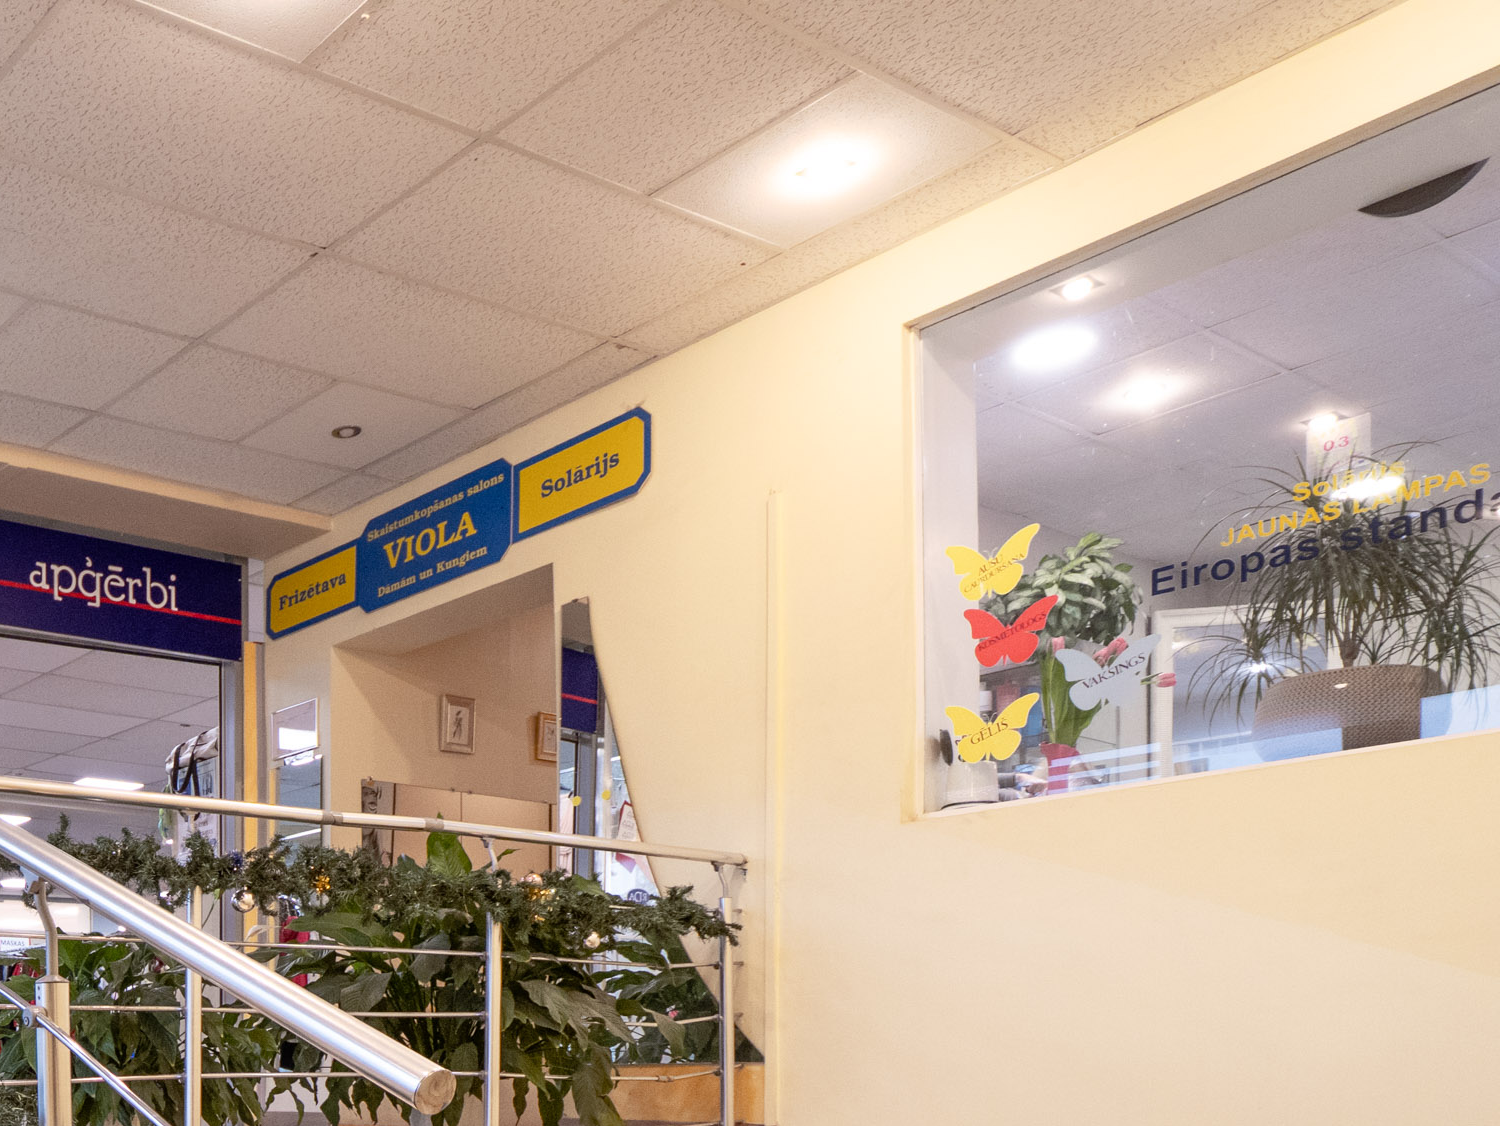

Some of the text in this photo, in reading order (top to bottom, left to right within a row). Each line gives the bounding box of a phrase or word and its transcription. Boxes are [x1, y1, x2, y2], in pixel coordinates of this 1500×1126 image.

[540, 450, 620, 499] Solārijs
[367, 473, 505, 542] Skaistumkopšanas salons
[1220, 463, 1491, 547] JAUNAS LAMPAS
[382, 511, 477, 569] VIOLA
[29, 557, 179, 612] apģērbi
[278, 572, 347, 611] Frizētava
[419, 567, 434, 581] un
[1151, 537, 1321, 597] Eiropas
[978, 611, 1047, 652] KOSMETOLOGS
[1082, 652, 1146, 689] VAKSINGS
